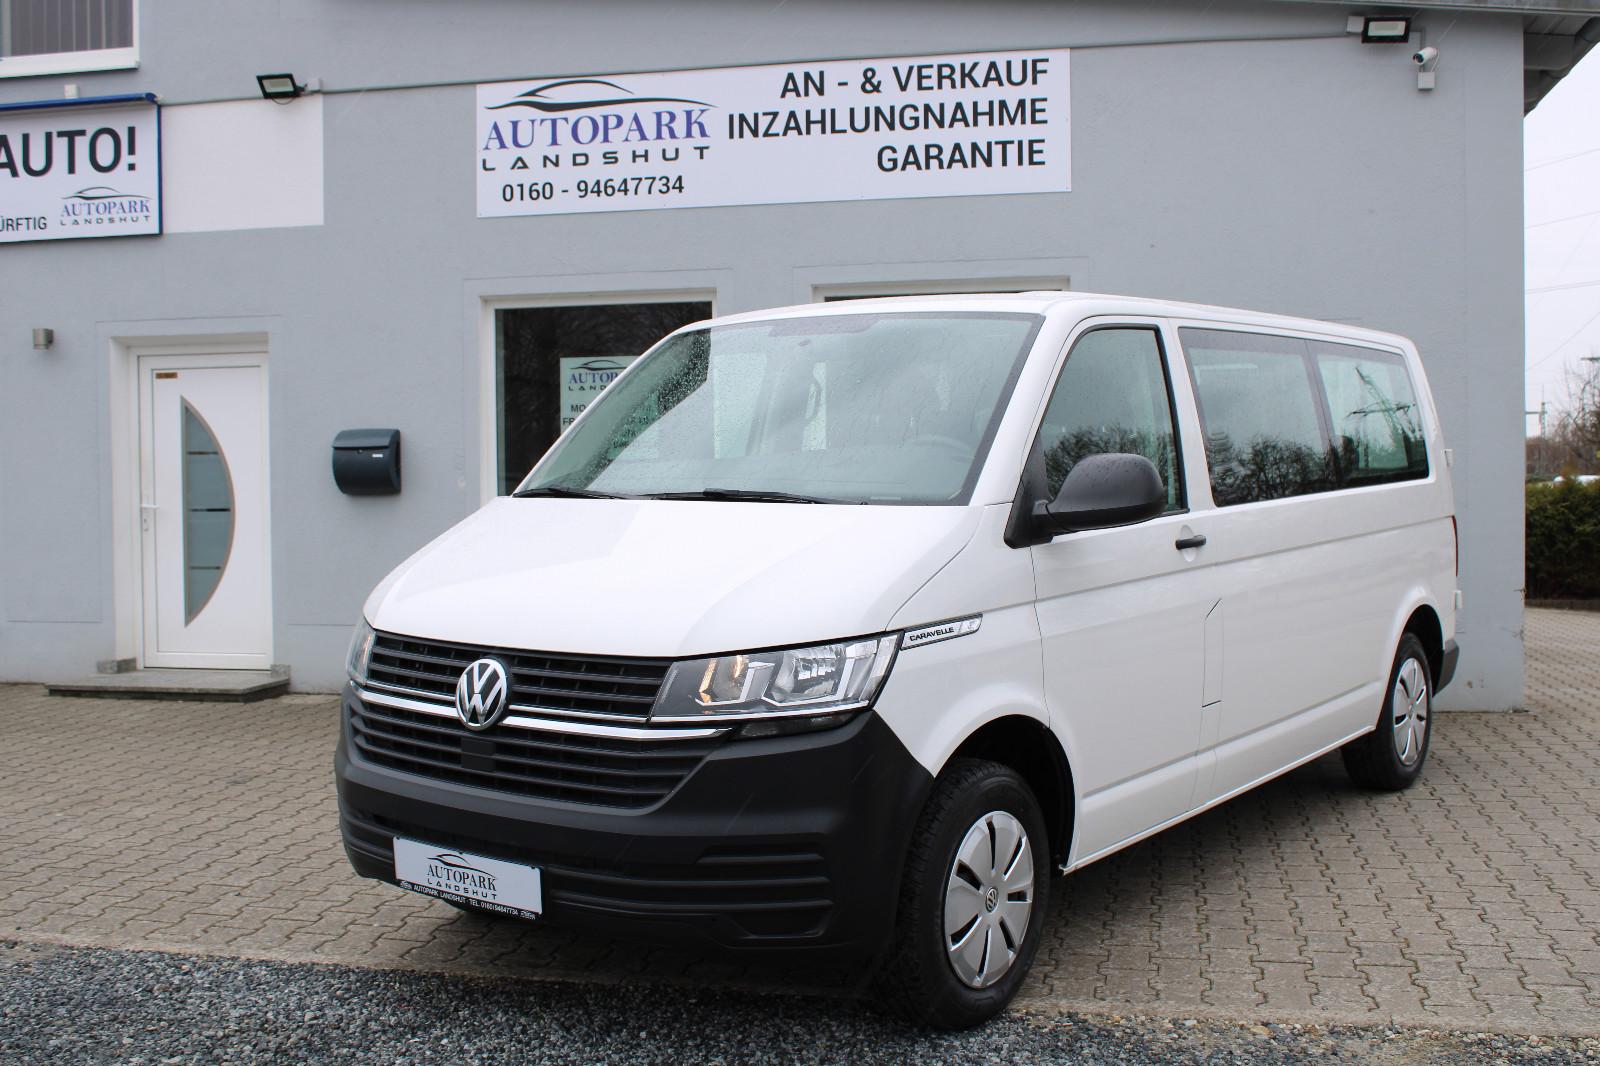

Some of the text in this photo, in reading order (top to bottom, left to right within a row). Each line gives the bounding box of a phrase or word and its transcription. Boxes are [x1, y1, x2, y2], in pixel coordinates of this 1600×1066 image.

[780, 71, 826, 99] AN
[860, 67, 883, 94] &
[892, 58, 1050, 92] VERKAUF
[482, 108, 711, 151] AUTOPARK
[728, 97, 1049, 140] INZAHLUNGNAHME
[482, 145, 711, 172] LANDSHUT
[877, 139, 1047, 173] GARANTIE
[502, 182, 554, 202] 0160
[576, 175, 685, 198] 94647734
[60, 200, 150, 217] AUTOPARK
[60, 215, 151, 226] LANDSHUT
[910, 627, 954, 641] CARAVELLE
[427, 863, 497, 892] AUTOPARK
[427, 878, 497, 901] LANDSHUT
[413, 884, 439, 896] AUTOPARK
[440, 892, 466, 904] LANDSHUT
